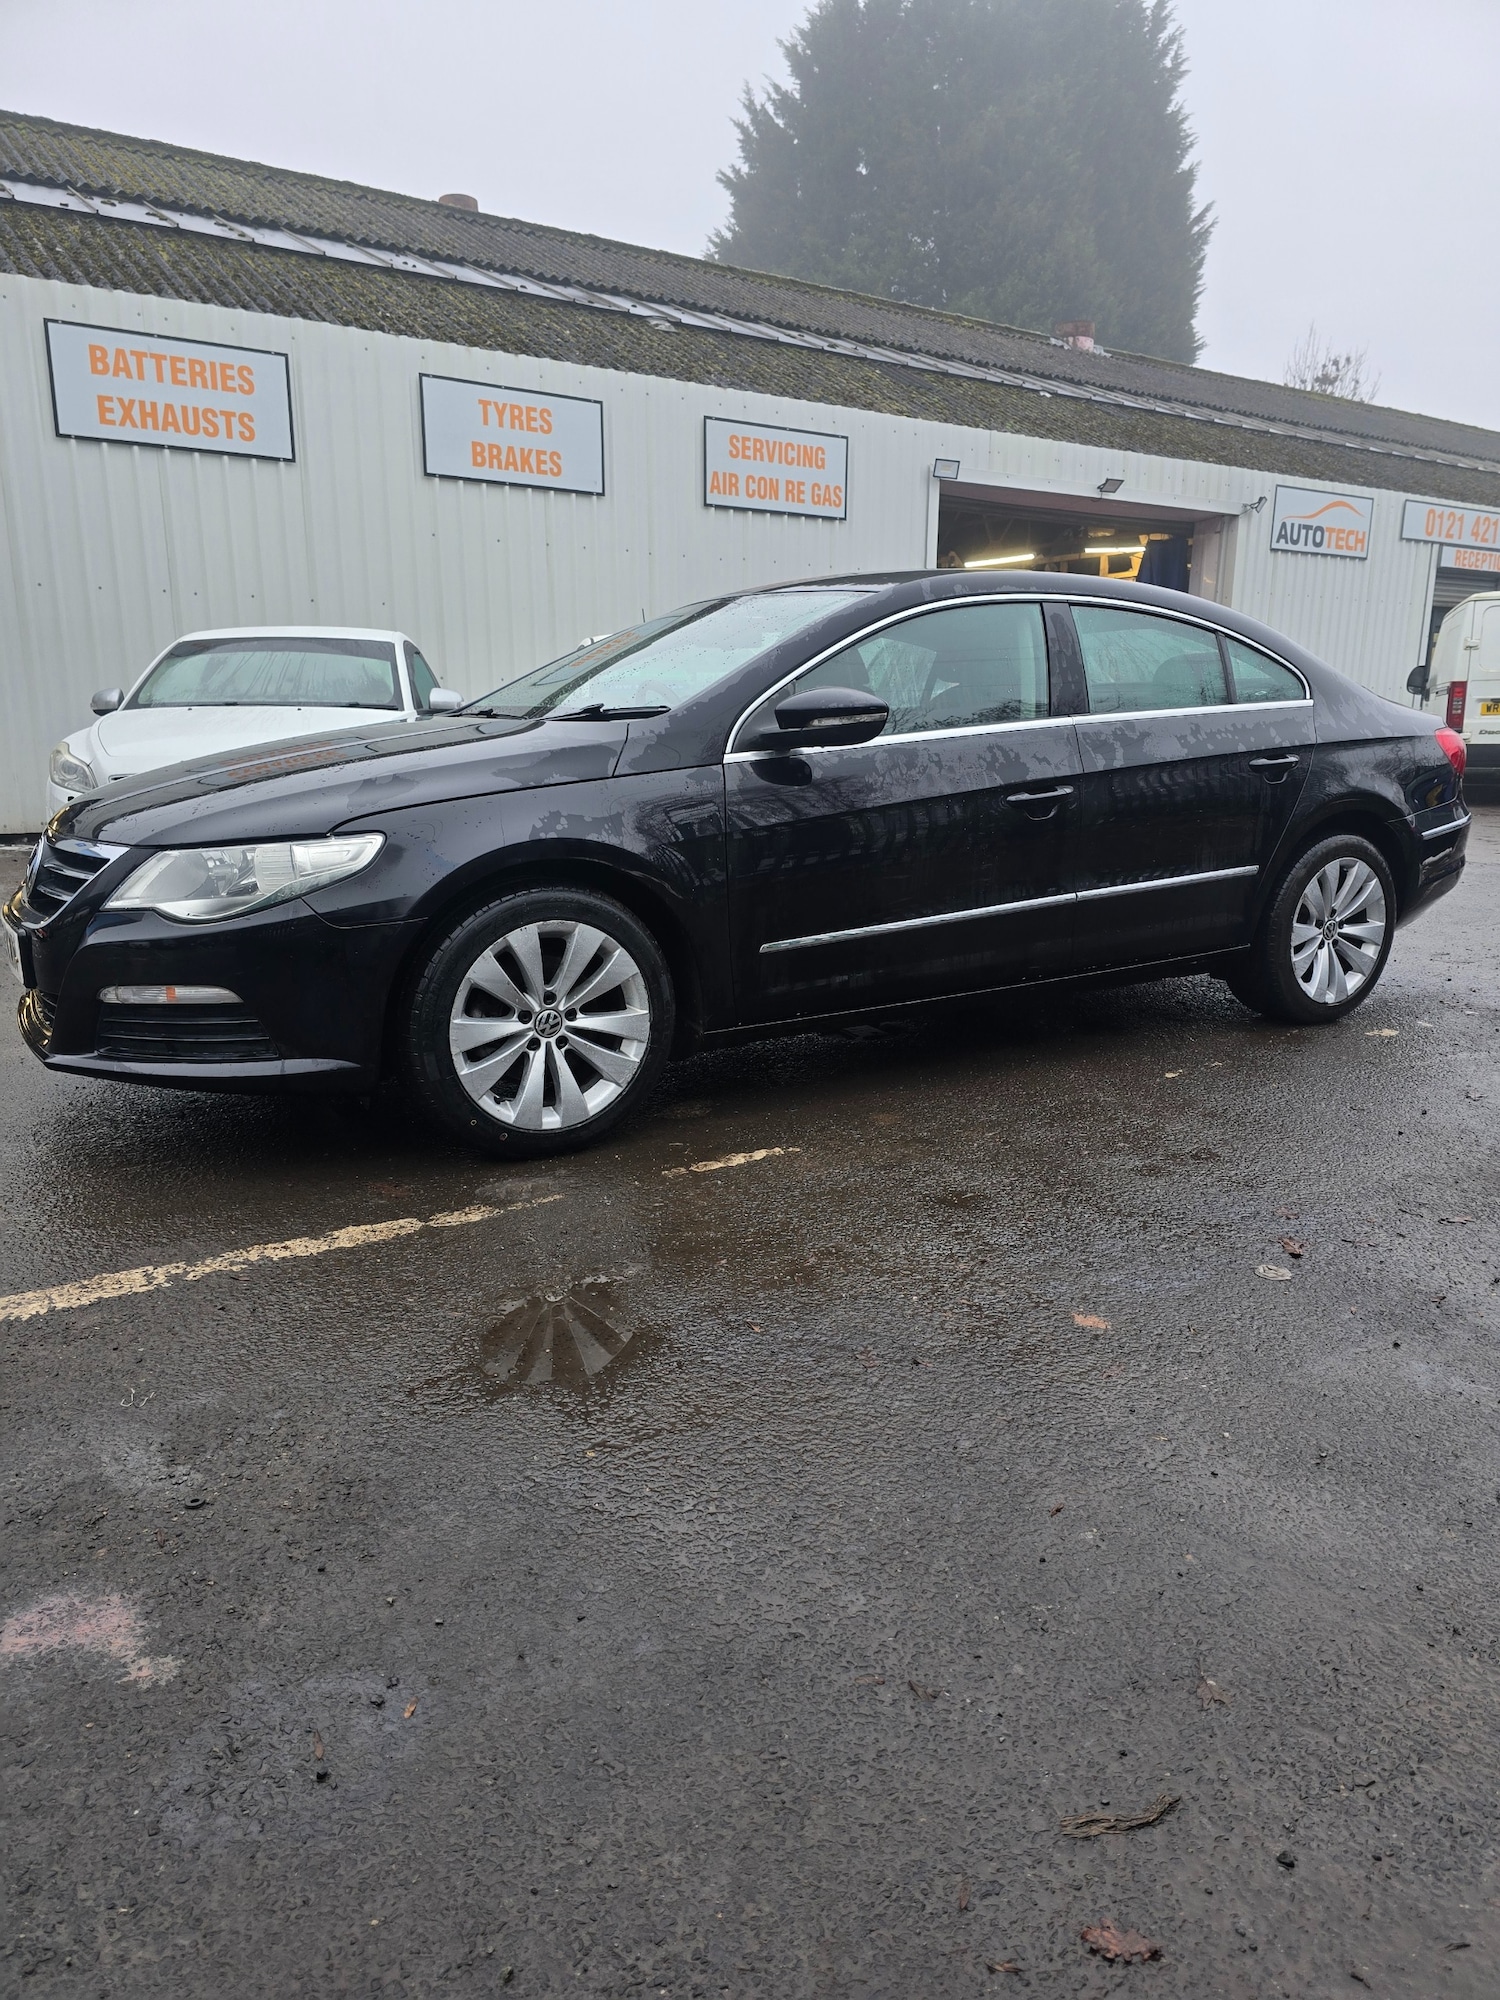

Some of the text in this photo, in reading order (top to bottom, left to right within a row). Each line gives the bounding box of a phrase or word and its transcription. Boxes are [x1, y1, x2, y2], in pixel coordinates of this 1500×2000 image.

[88, 344, 255, 396] BATTERIES
[96, 394, 256, 442] EXHAUSTS
[478, 398, 553, 435] TYRES
[471, 440, 562, 477] BRAKES
[728, 434, 826, 470] SERVICING
[709, 471, 843, 508] AIR CON RE GAS
[1276, 521, 1367, 552] AUTOTECH
[1425, 508, 1500, 544] 0121 421
